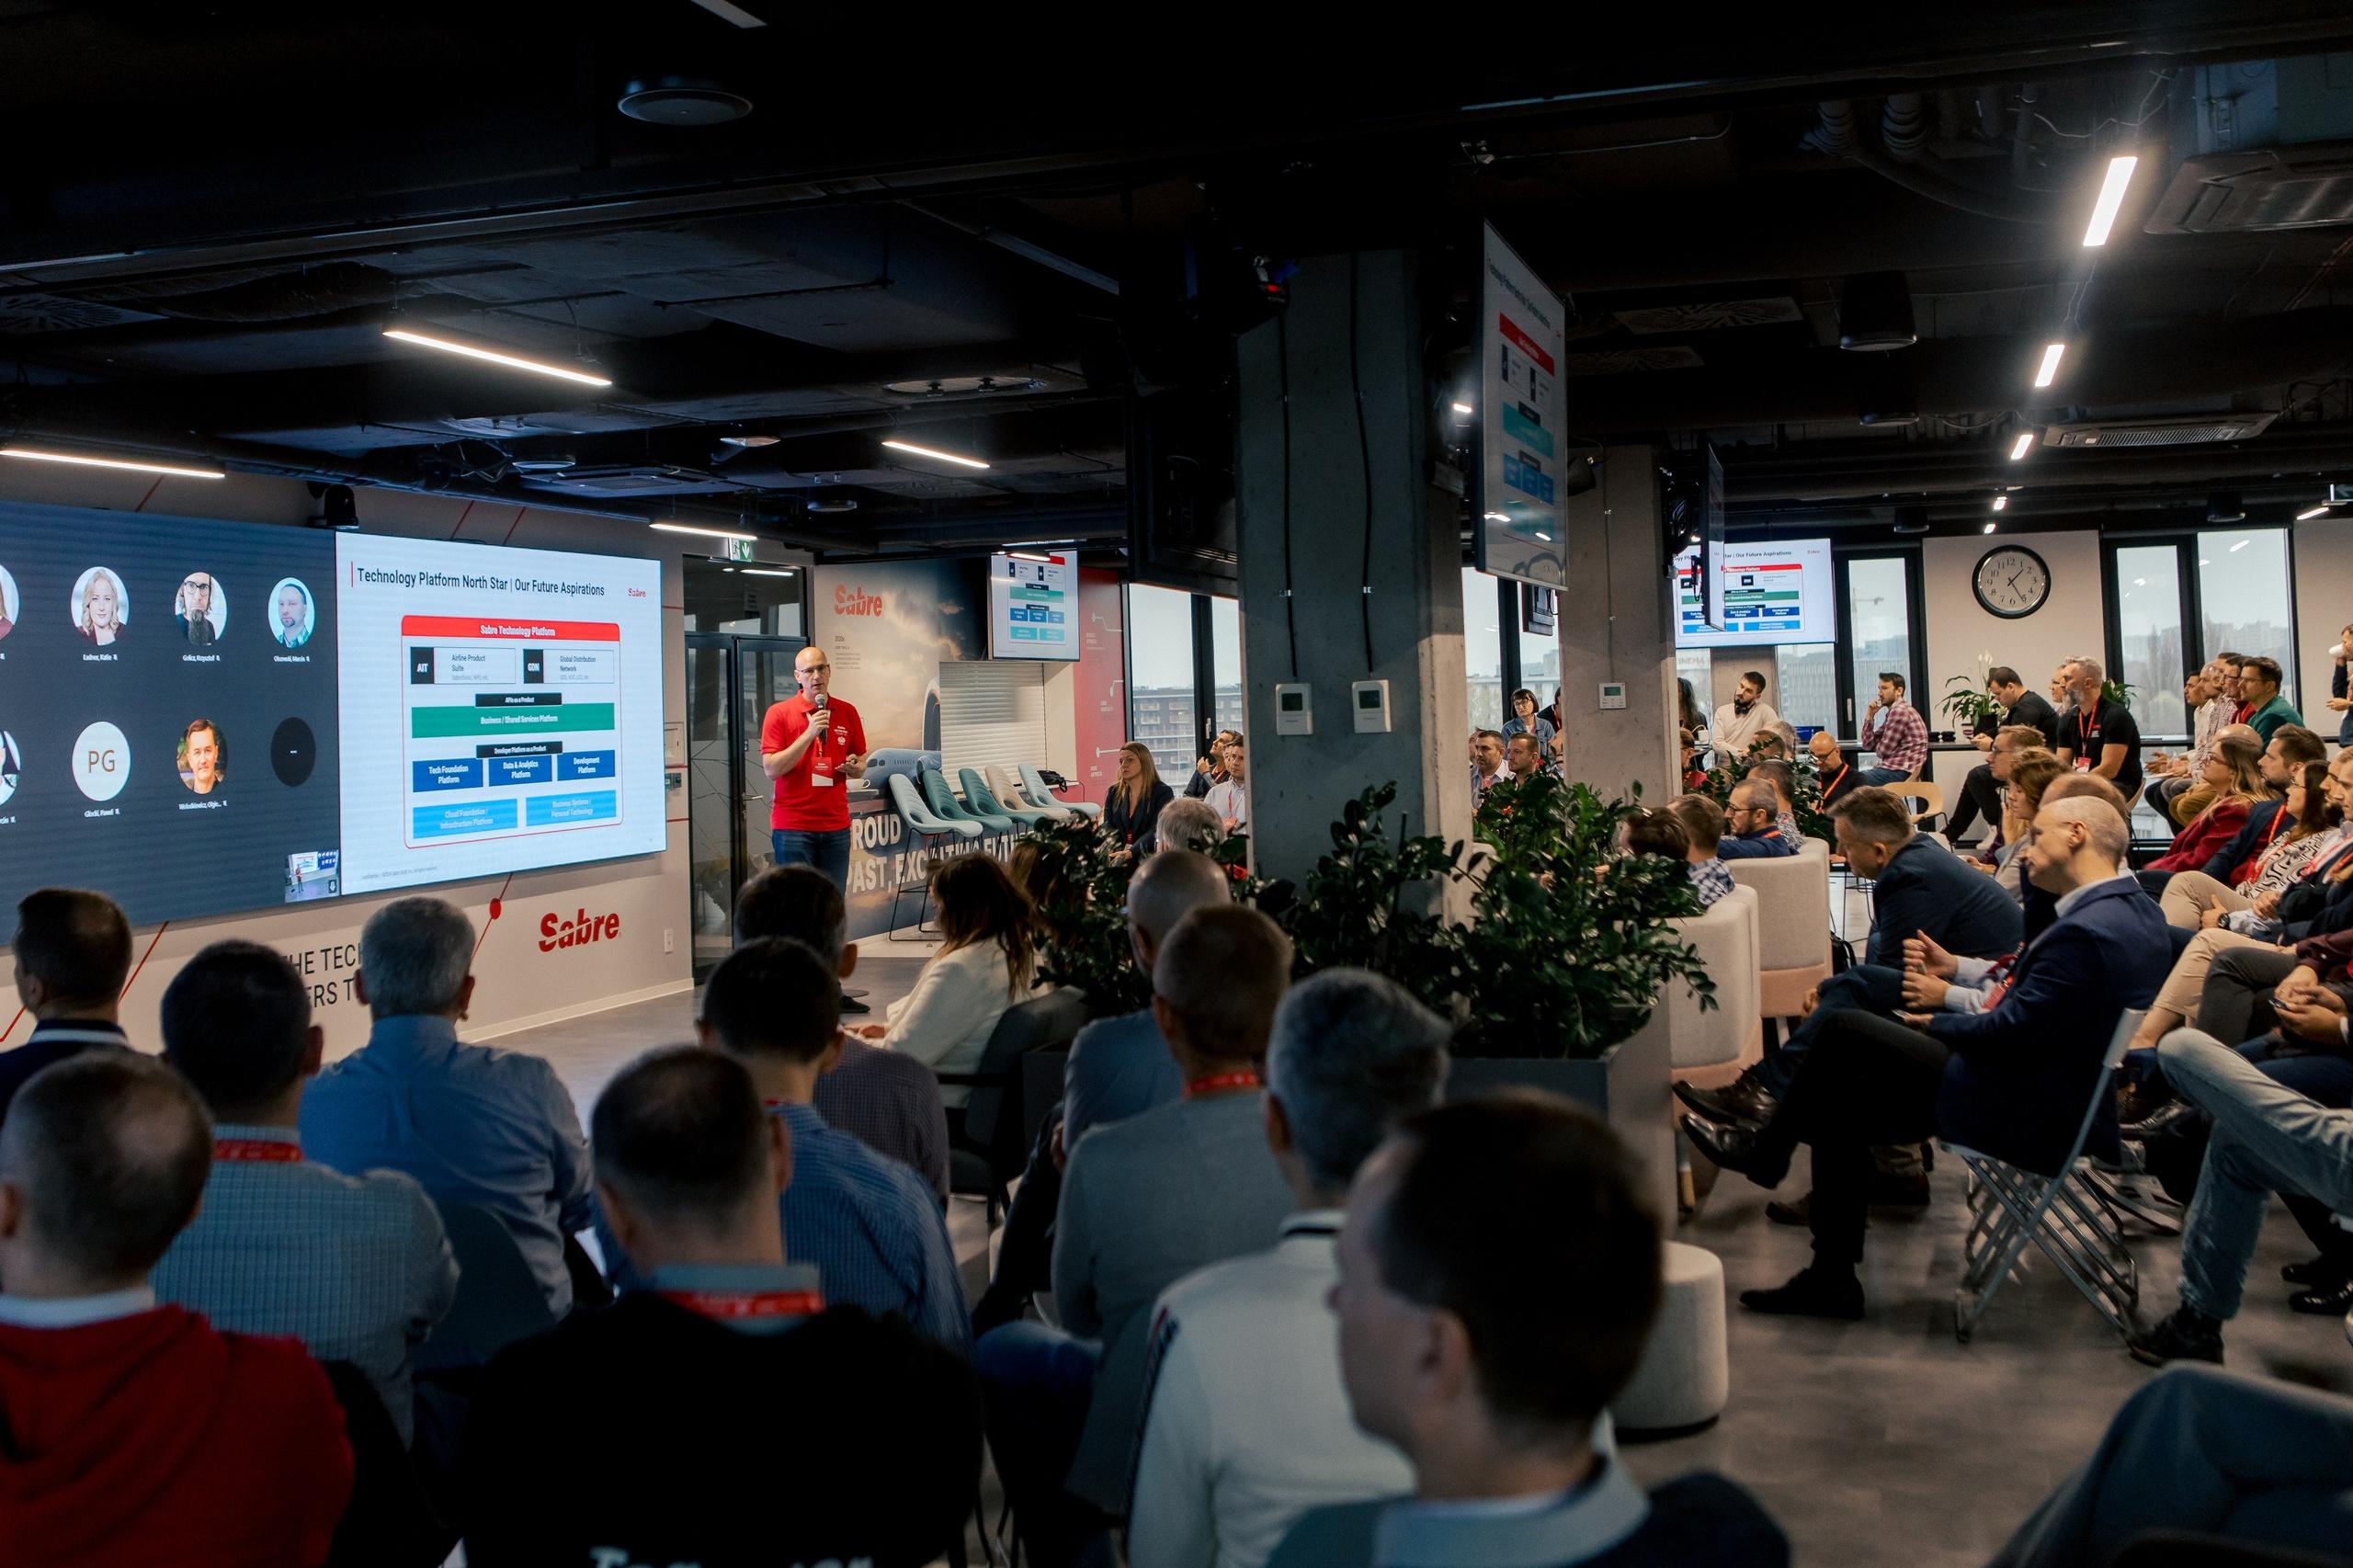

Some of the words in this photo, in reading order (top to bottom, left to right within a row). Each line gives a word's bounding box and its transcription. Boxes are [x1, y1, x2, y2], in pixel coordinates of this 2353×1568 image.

[2006, 558, 2016, 566] 12
[2026, 566, 2032, 574] 2
[357, 567, 416, 588] Technology
[419, 571, 460, 587] Platform
[462, 574, 488, 589] North
[490, 576, 508, 590] Star
[515, 578, 530, 592] Our
[532, 579, 559, 594] Future
[561, 581, 605, 597] Aspirations
[1986, 578, 1993, 586] 9
[2032, 576, 2038, 585] 3
[628, 587, 646, 598] Sabre
[834, 584, 882, 617] Sabre
[2009, 597, 2016, 606] 6
[480, 624, 498, 635] Sabre
[498, 625, 531, 638] Technology
[531, 626, 556, 637] Platform
[468, 653, 486, 662] Product
[540, 714, 558, 722] Platform
[88, 749, 116, 774] PG
[428, 766, 441, 775] Tech
[441, 765, 469, 774] Foundation
[511, 770, 531, 779] Platform
[438, 776, 460, 784] Platform
[850, 813, 902, 851] ROUD
[539, 907, 620, 953] Sabre
